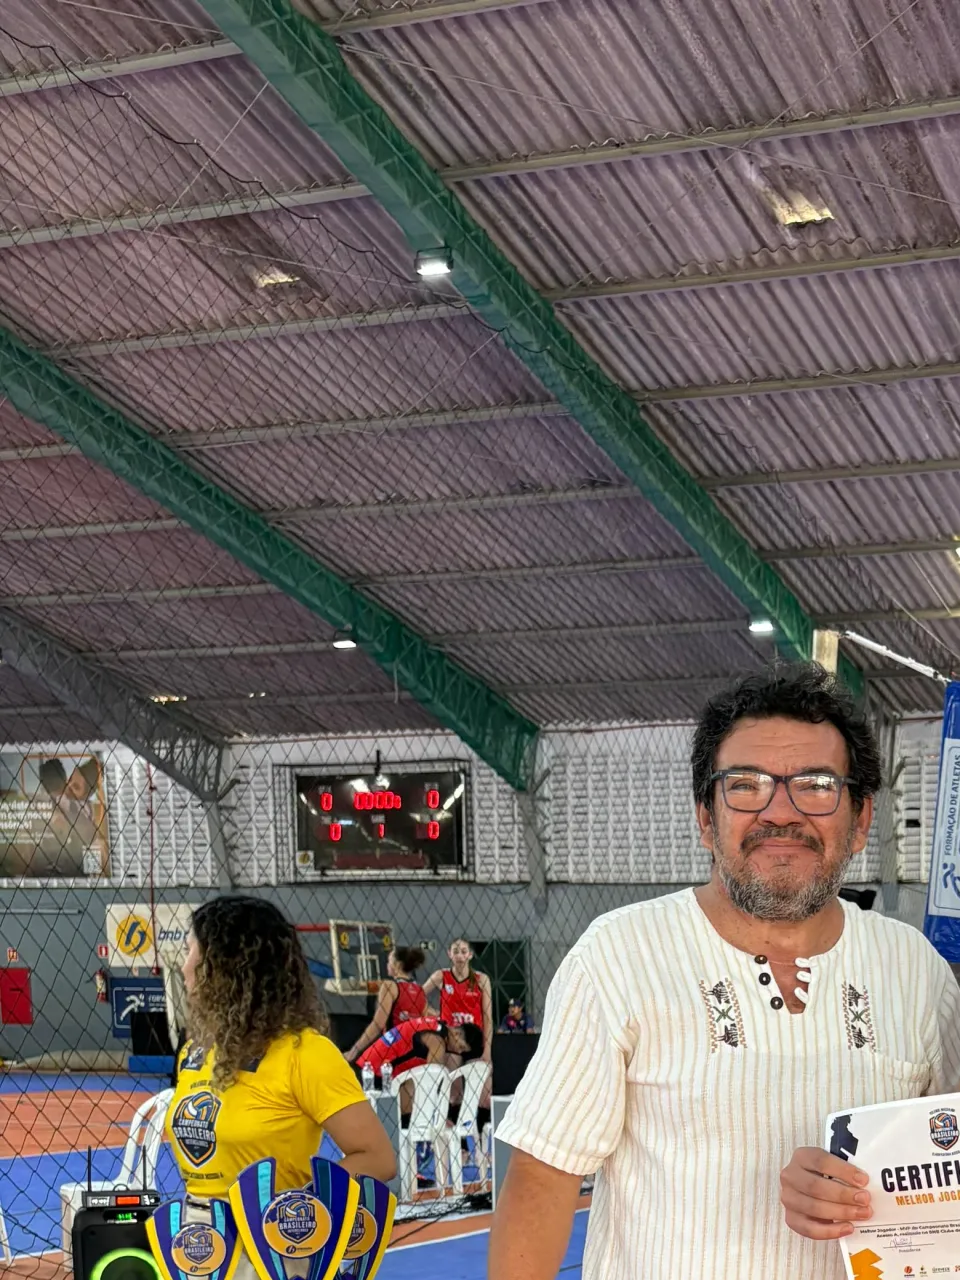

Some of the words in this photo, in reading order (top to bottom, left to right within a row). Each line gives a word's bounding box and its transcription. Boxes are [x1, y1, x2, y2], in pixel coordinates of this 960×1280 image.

[321, 793, 333, 811] 0
[427, 790, 440, 809] 0
[950, 794, 958, 806] DE
[329, 823, 342, 841] 0
[427, 821, 440, 840] 0
[944, 806, 957, 856] FORMAÇÃO
[158, 927, 181, 941] bnb
[178, 1119, 209, 1129] CAMPEONATO
[173, 1127, 216, 1143] BRASILEIRO
[895, 1192, 935, 1206] MELHOR
[279, 1221, 317, 1230] BRASILEIRO
